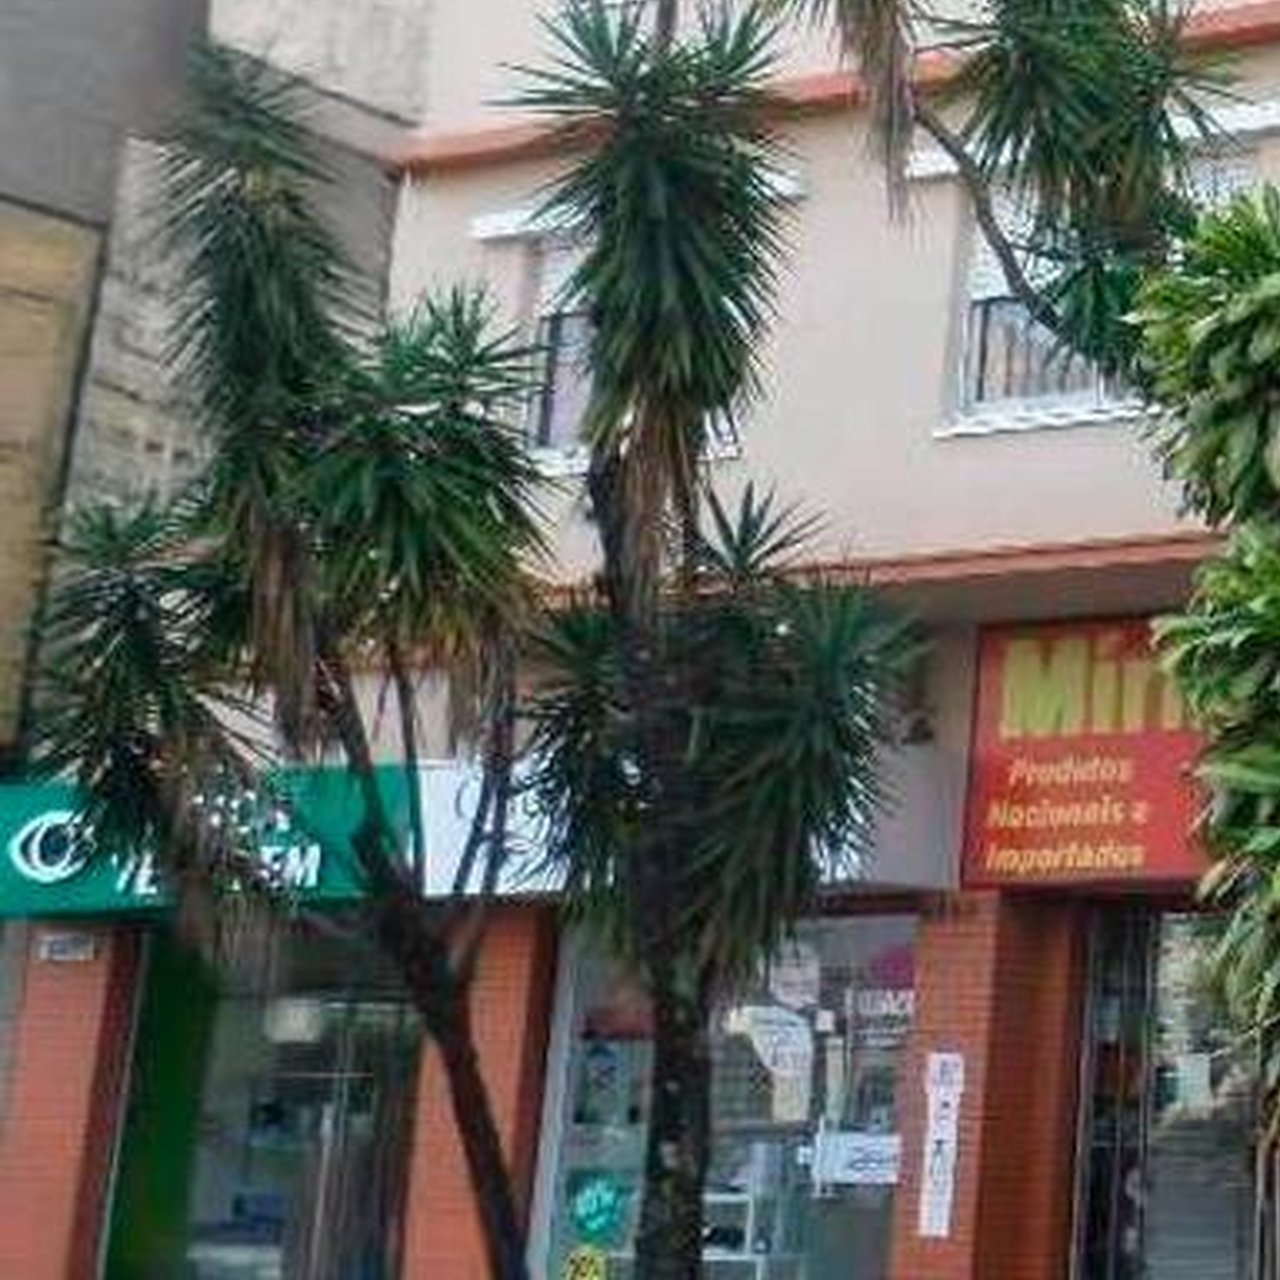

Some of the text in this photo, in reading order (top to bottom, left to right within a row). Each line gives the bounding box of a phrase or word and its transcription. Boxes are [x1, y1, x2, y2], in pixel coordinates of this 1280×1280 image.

[1007, 753, 1135, 788] Produtos
[986, 795, 1127, 829] Nacionais
[985, 842, 1146, 874] Importados
